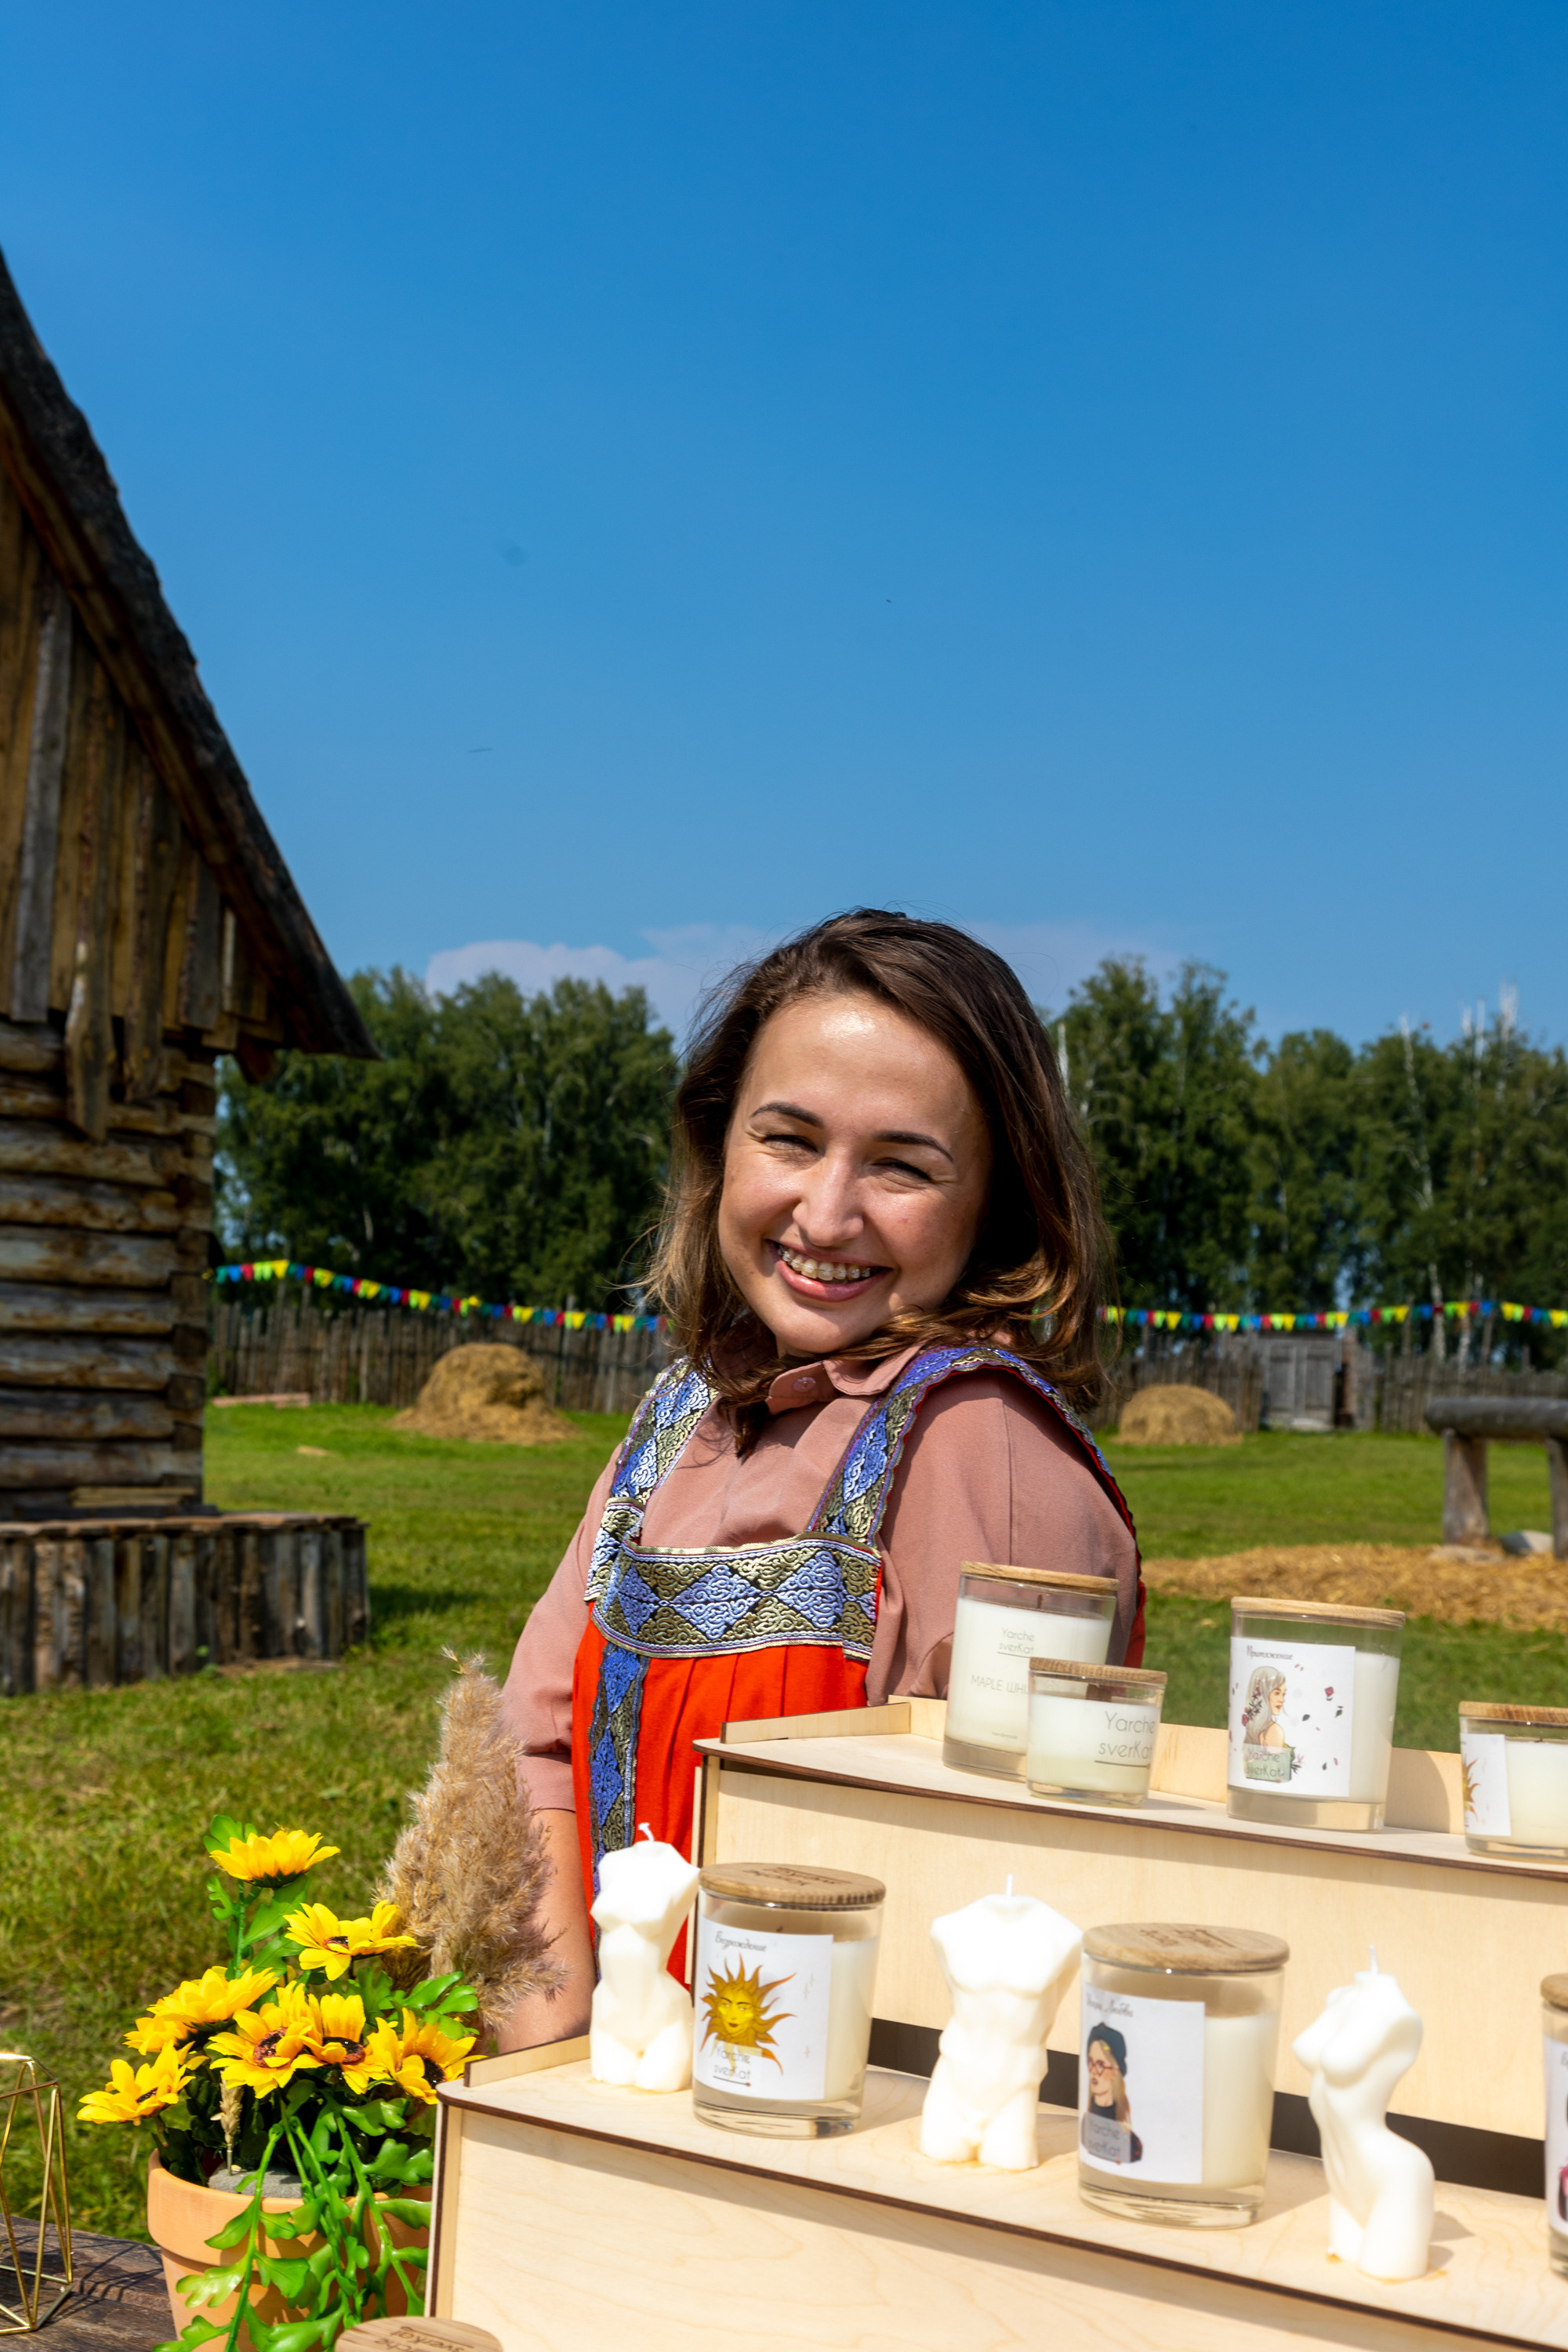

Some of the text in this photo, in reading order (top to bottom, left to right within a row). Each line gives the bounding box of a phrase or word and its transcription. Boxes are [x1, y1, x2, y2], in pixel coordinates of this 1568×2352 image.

[1001, 1626, 1035, 1642] Yarche
[971, 1674, 1028, 1694] MAPLE WHI
[1105, 1710, 1156, 1734] Yarche
